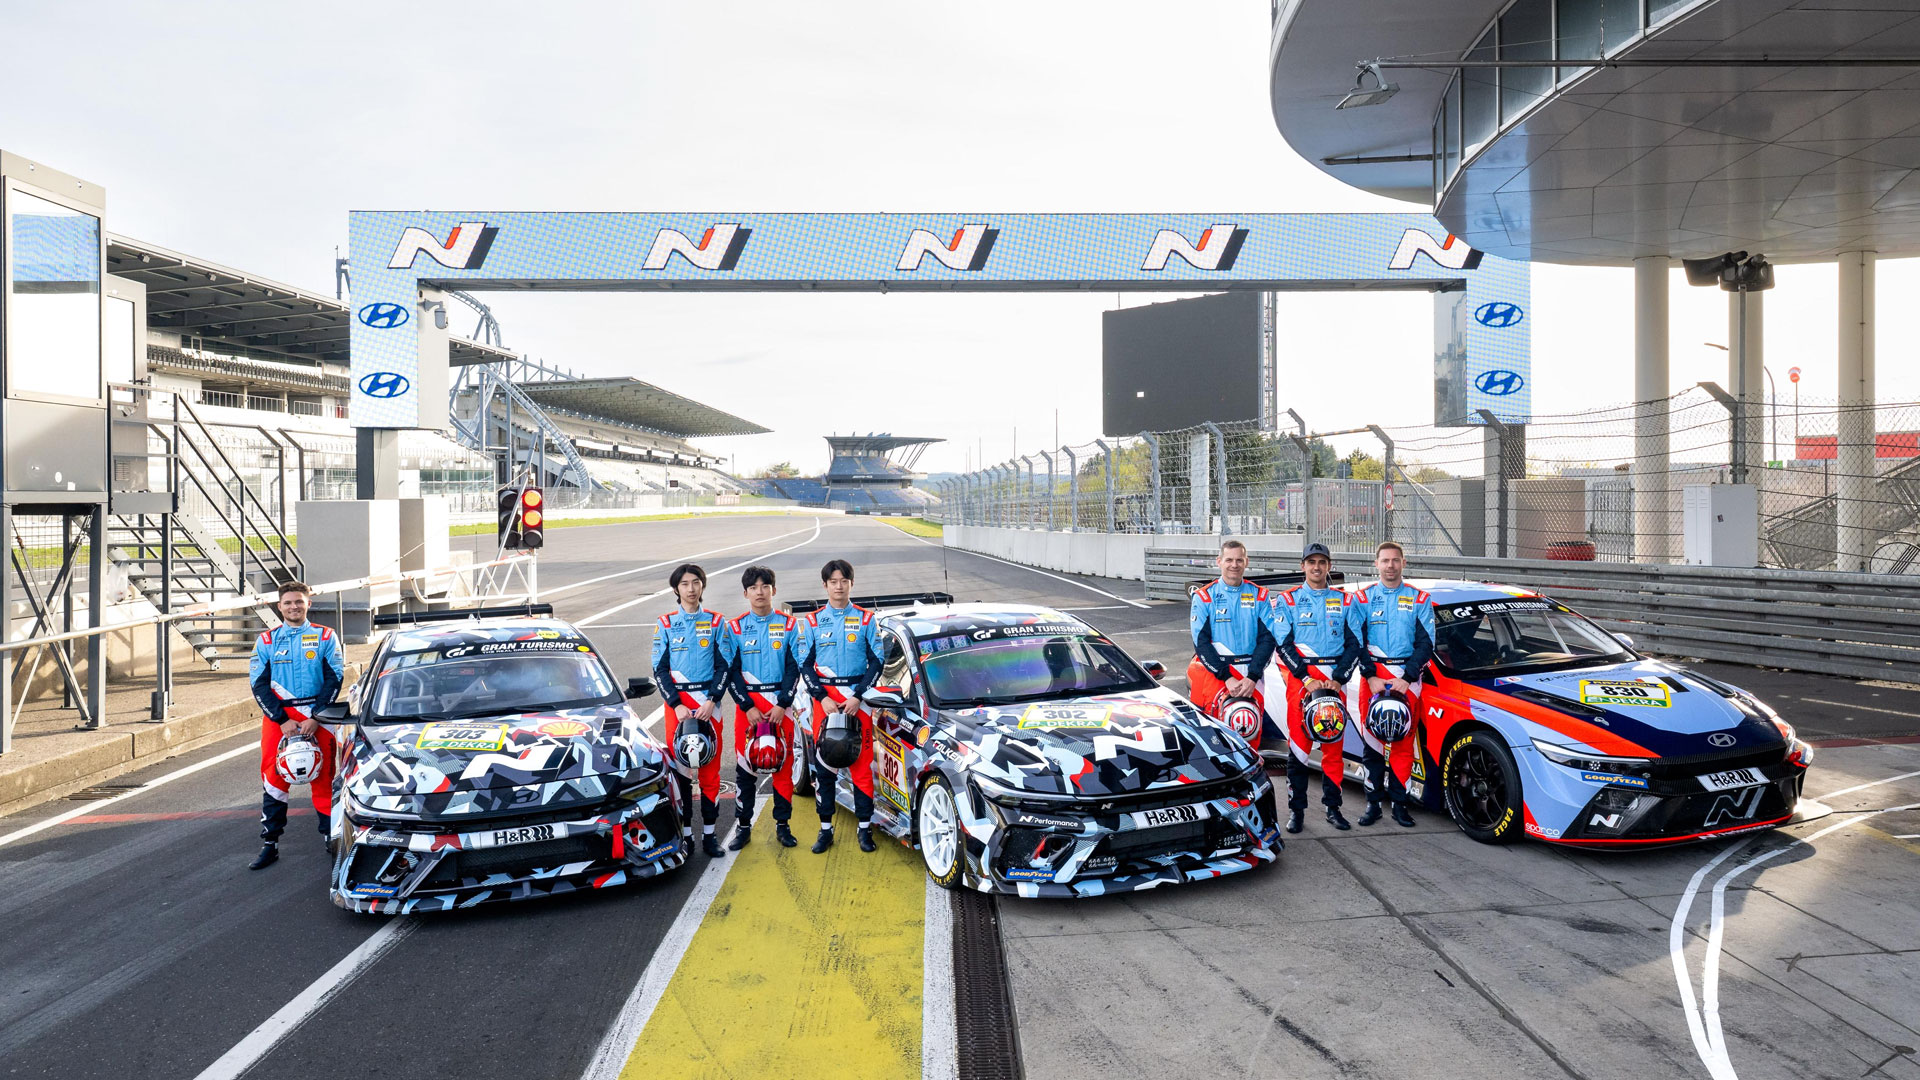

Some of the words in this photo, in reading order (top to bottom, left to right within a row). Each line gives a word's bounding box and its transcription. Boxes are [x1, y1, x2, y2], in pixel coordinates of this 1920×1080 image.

[1478, 602, 1507, 612] GRAN
[1506, 602, 1549, 610] TURISMO
[1003, 626, 1035, 635] GRAN
[1036, 625, 1084, 633] TURISMO
[481, 642, 516, 652] GRAN
[519, 642, 574, 650] TURISMO
[1603, 686, 1648, 697] 830
[1608, 697, 1662, 706] DEKRA
[1043, 710, 1088, 720] 302
[1047, 720, 1097, 728] DEKRA
[440, 729, 483, 740] 303
[448, 741, 496, 749] DEKRA
[883, 753, 899, 786] 302
[1584, 774, 1645, 786] GOODYEAR
[1708, 772, 1741, 787] H&R
[889, 789, 909, 812] DEKRA
[1034, 817, 1079, 828] Performance
[1145, 809, 1179, 826] H&R
[1494, 807, 1514, 837] EAGLE
[1525, 822, 1560, 836] sparco
[494, 829, 531, 846] H&R
[1009, 871, 1053, 879] GOODYEAR
